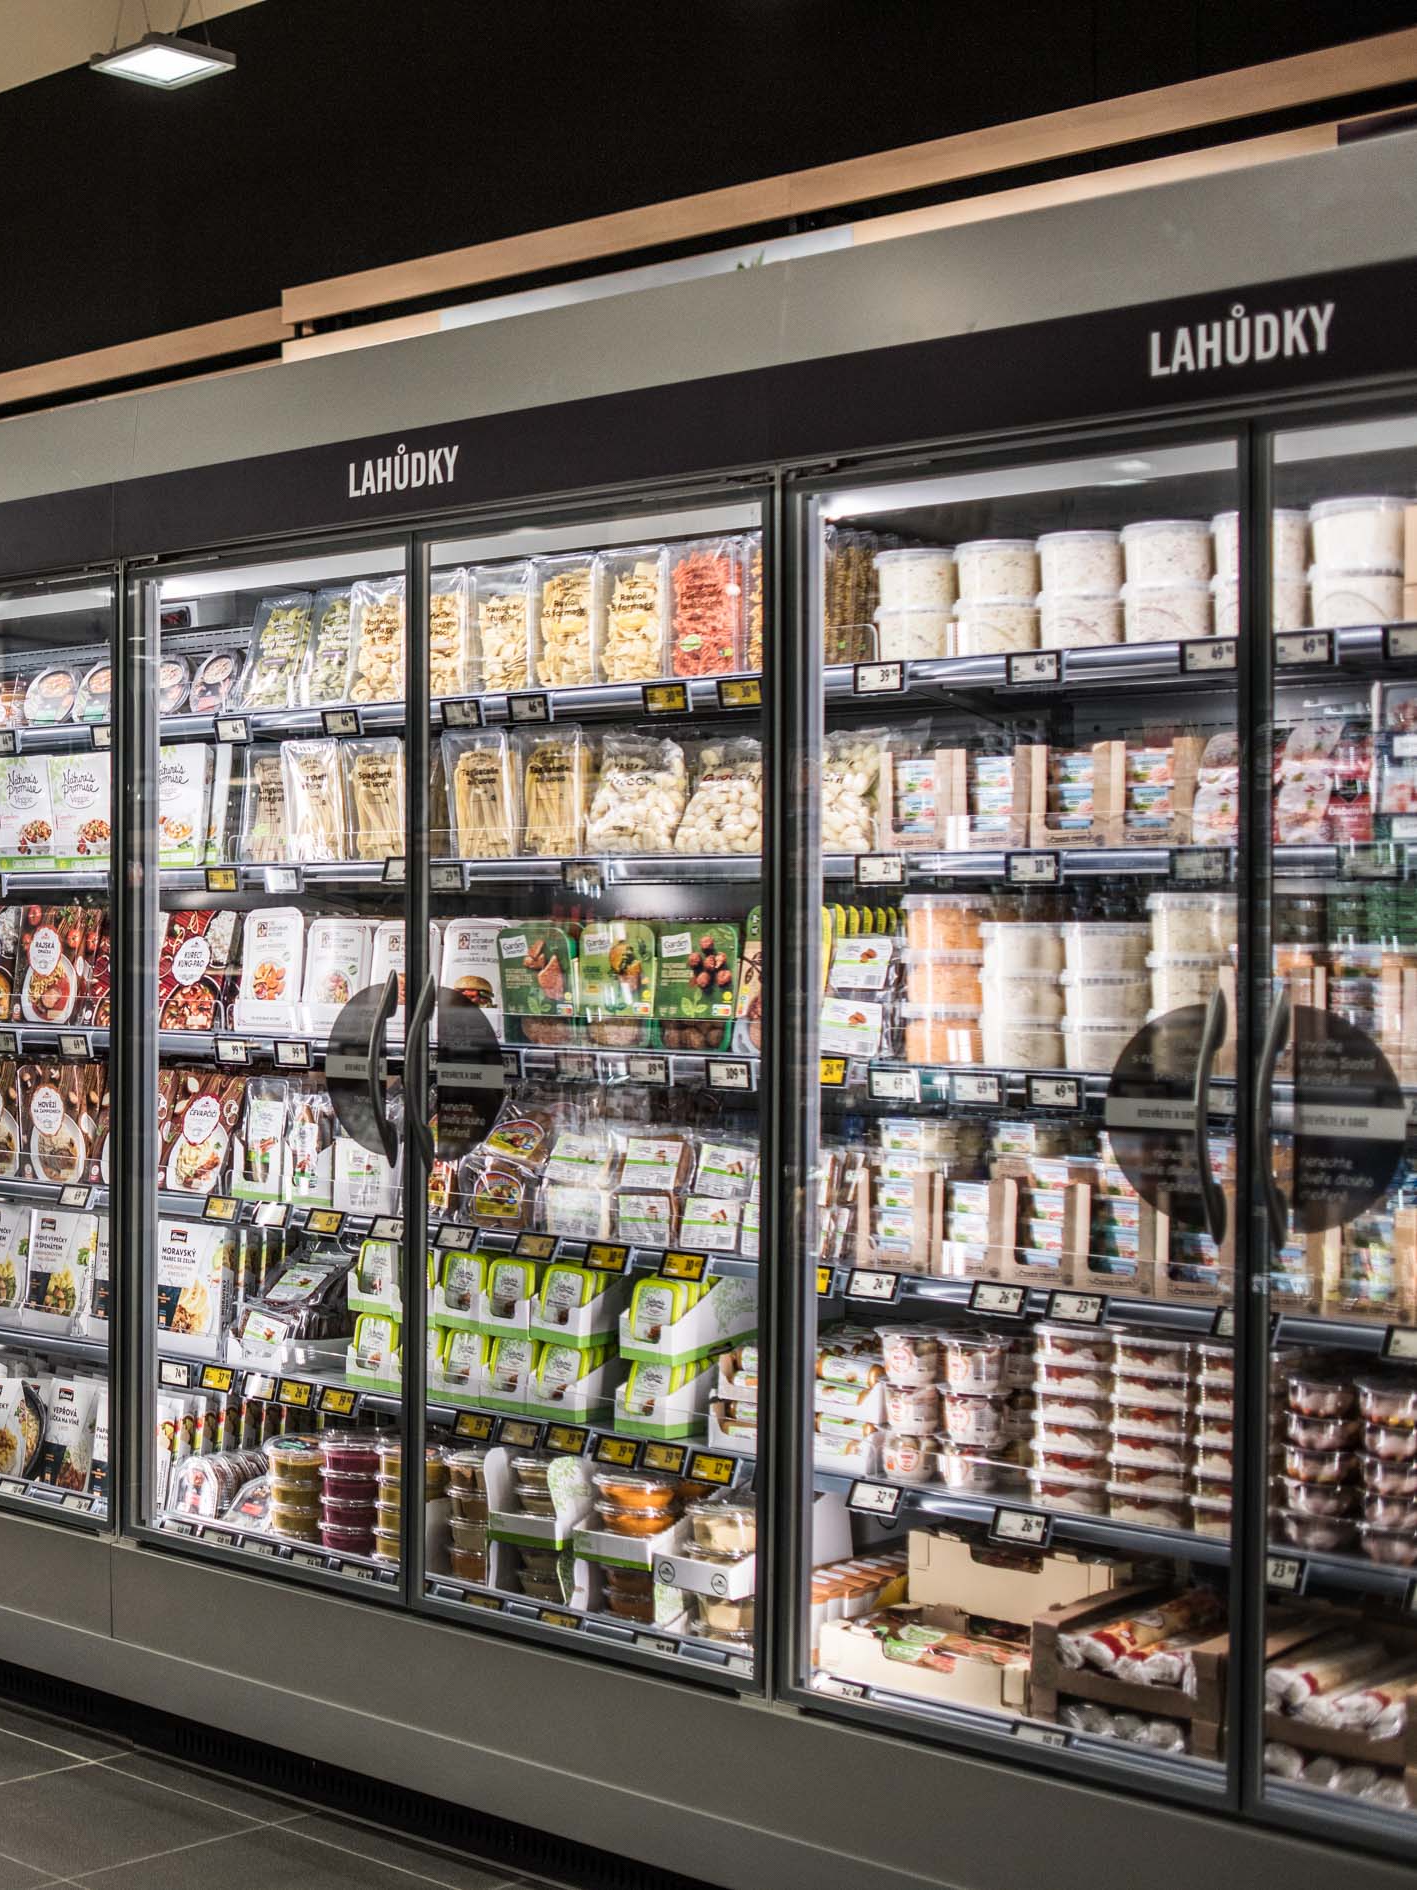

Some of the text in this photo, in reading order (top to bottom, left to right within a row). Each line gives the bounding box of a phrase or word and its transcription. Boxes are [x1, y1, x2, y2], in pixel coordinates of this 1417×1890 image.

[1150, 304, 1335, 377] LAHŮDKY
[349, 443, 459, 498] LAHŮDKY
[161, 1247, 196, 1257] MORAVSKÝ
[53, 1405, 78, 1417] VEPŘOVÁ
